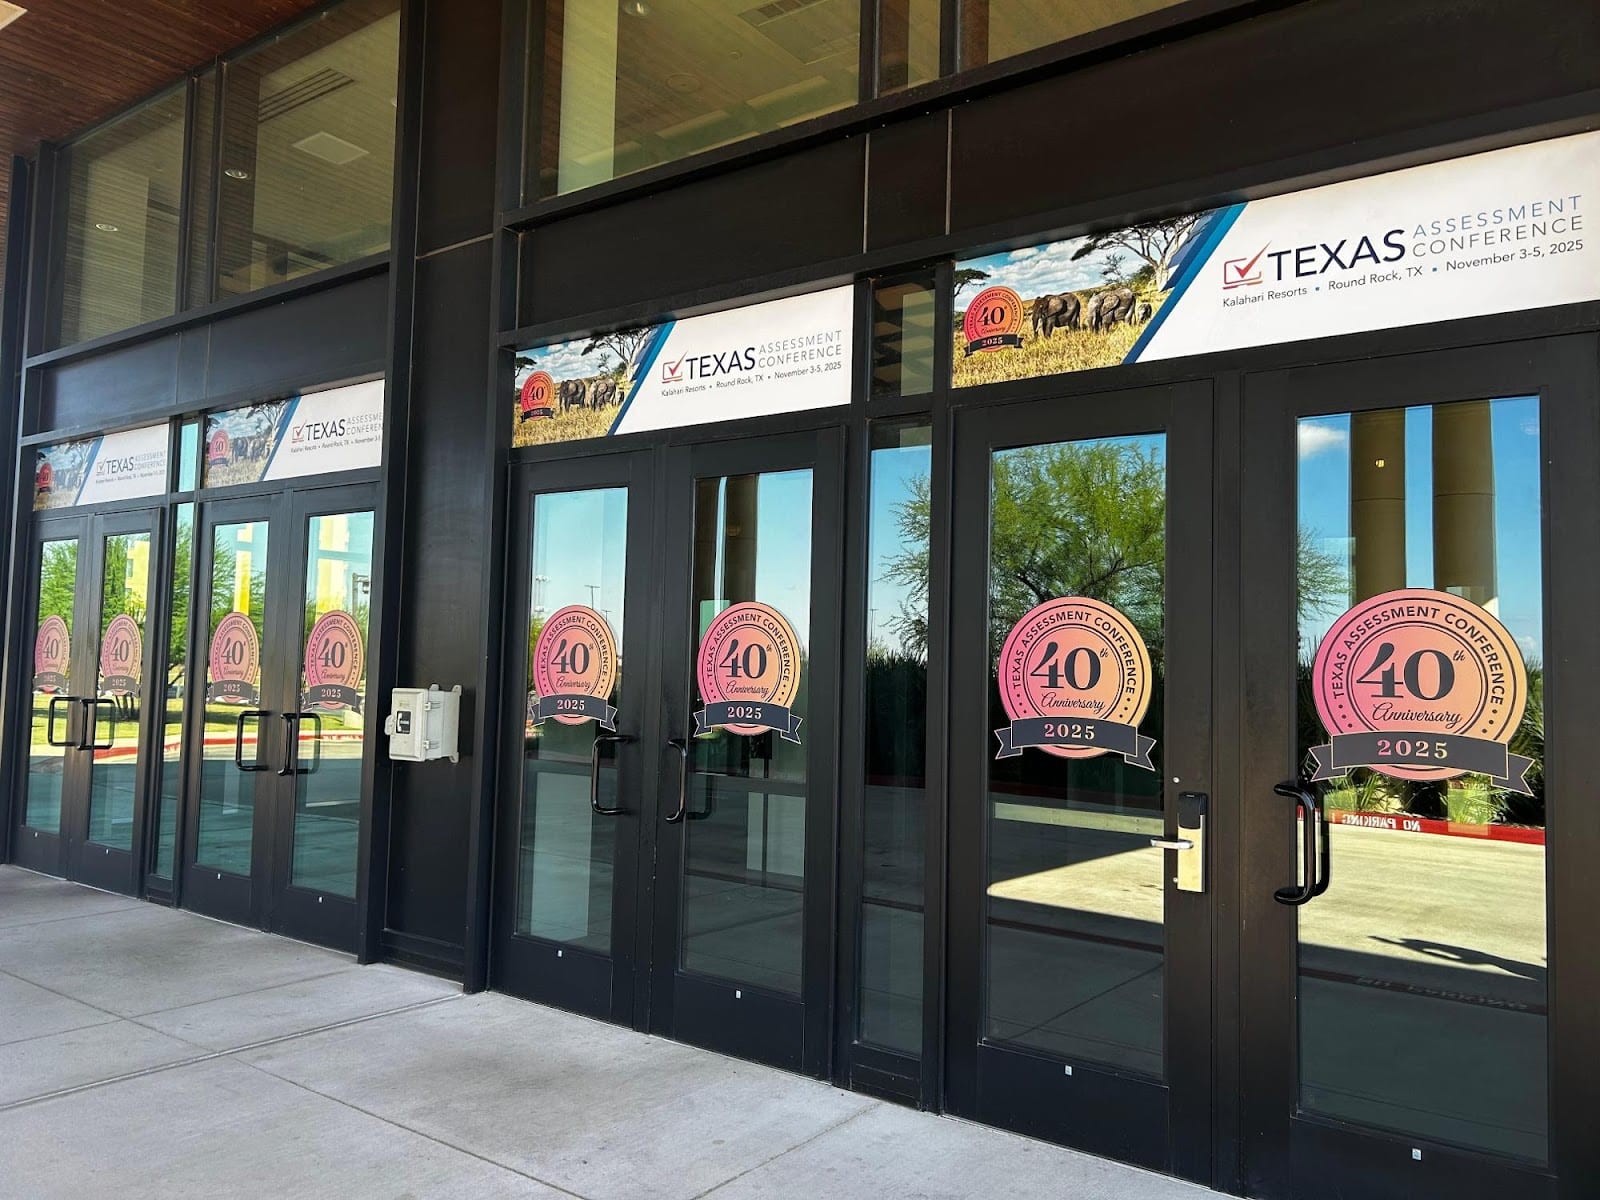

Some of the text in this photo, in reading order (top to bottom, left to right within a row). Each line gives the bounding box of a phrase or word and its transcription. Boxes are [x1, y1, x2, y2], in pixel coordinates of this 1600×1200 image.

[1412, 195, 1582, 239] ASSESSMENT
[1412, 215, 1583, 257] CONFERENCE
[1267, 229, 1406, 281] TEXAS
[1223, 239, 1583, 307] Kalahari Resorts Round Rock, TX November 3-5, 2025
[758, 330, 842, 355] ASSESSMENT
[685, 347, 756, 380] TEXAS
[758, 344, 842, 369] CONFERENCE
[716, 378, 735, 388] Round
[755, 374, 764, 382] TX
[774, 367, 808, 379] November
[824, 361, 842, 372] 2025
[305, 418, 346, 441] TEXAS
[346, 412, 383, 425] ASSESSME
[106, 456, 134, 474] TEXAS
[547, 615, 586, 644] ASSESSMENT
[586, 620, 609, 676] CONFERENCE
[707, 613, 791, 681] TEXAS ASSESSMENT CONFERENCE
[1012, 610, 1137, 694] TEXAS ASSESSMENT CONFERENCE
[1331, 605, 1505, 705] TEXAS ASSESSMENT CONFERENCE
[321, 688, 342, 699] 2025
[725, 680, 769, 698] Anniversary
[556, 699, 585, 711] 2025
[727, 706, 762, 720] 2025
[1040, 691, 1105, 715] Anniversary
[1372, 701, 1463, 729] Anniversary
[1044, 723, 1095, 740] 2025
[1377, 739, 1448, 760] 2025
